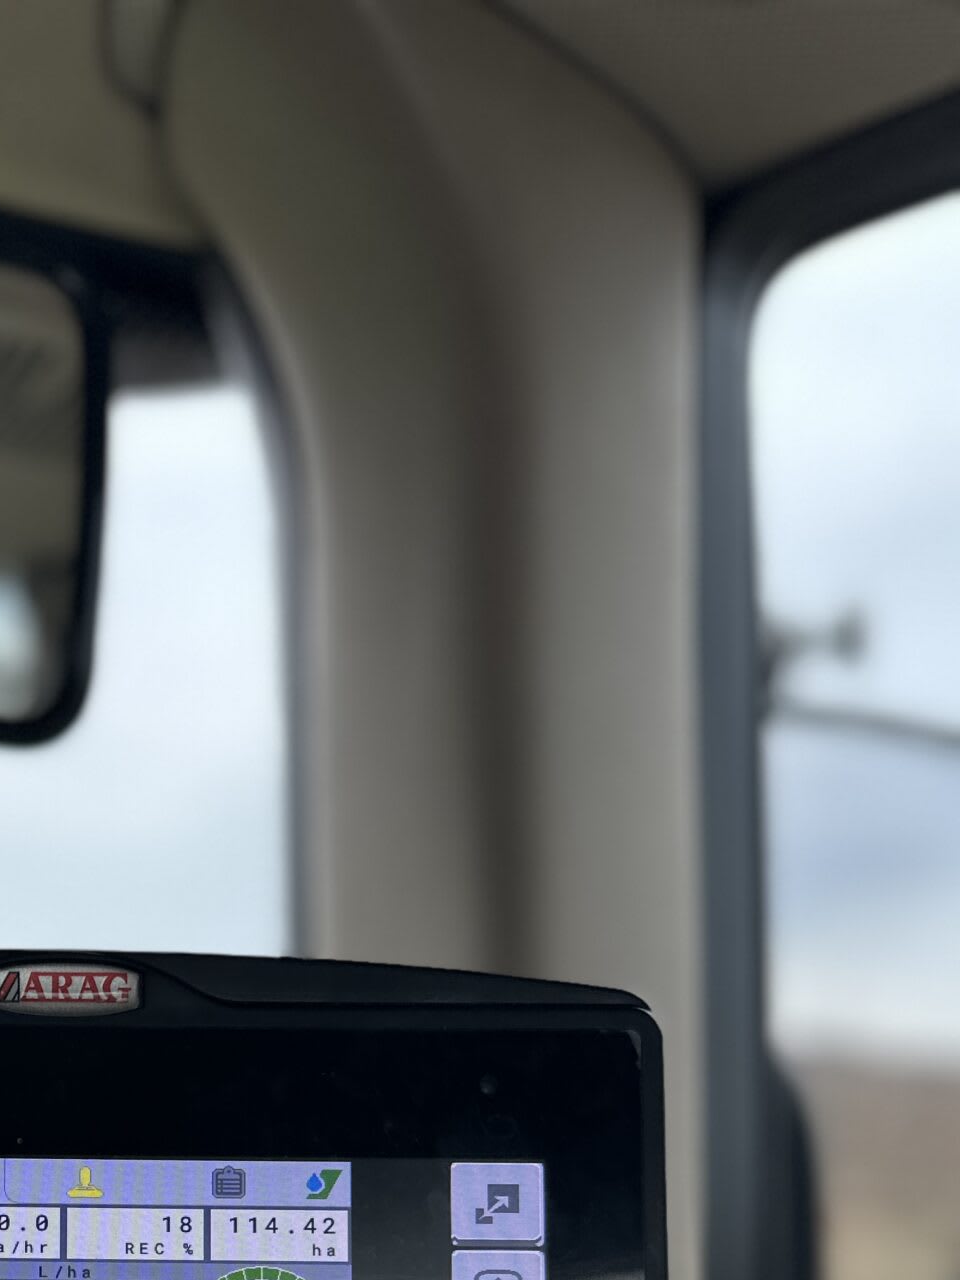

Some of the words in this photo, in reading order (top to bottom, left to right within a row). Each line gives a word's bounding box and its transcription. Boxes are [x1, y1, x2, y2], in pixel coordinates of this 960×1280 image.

[20, 971, 132, 1003] ARAG
[162, 1216, 193, 1233] 18
[229, 1217, 337, 1235] 114.42
[125, 1243, 165, 1255] REC
[183, 1243, 194, 1255] %
[312, 1244, 336, 1257] ha
[39, 1265, 91, 1279] L/ha
